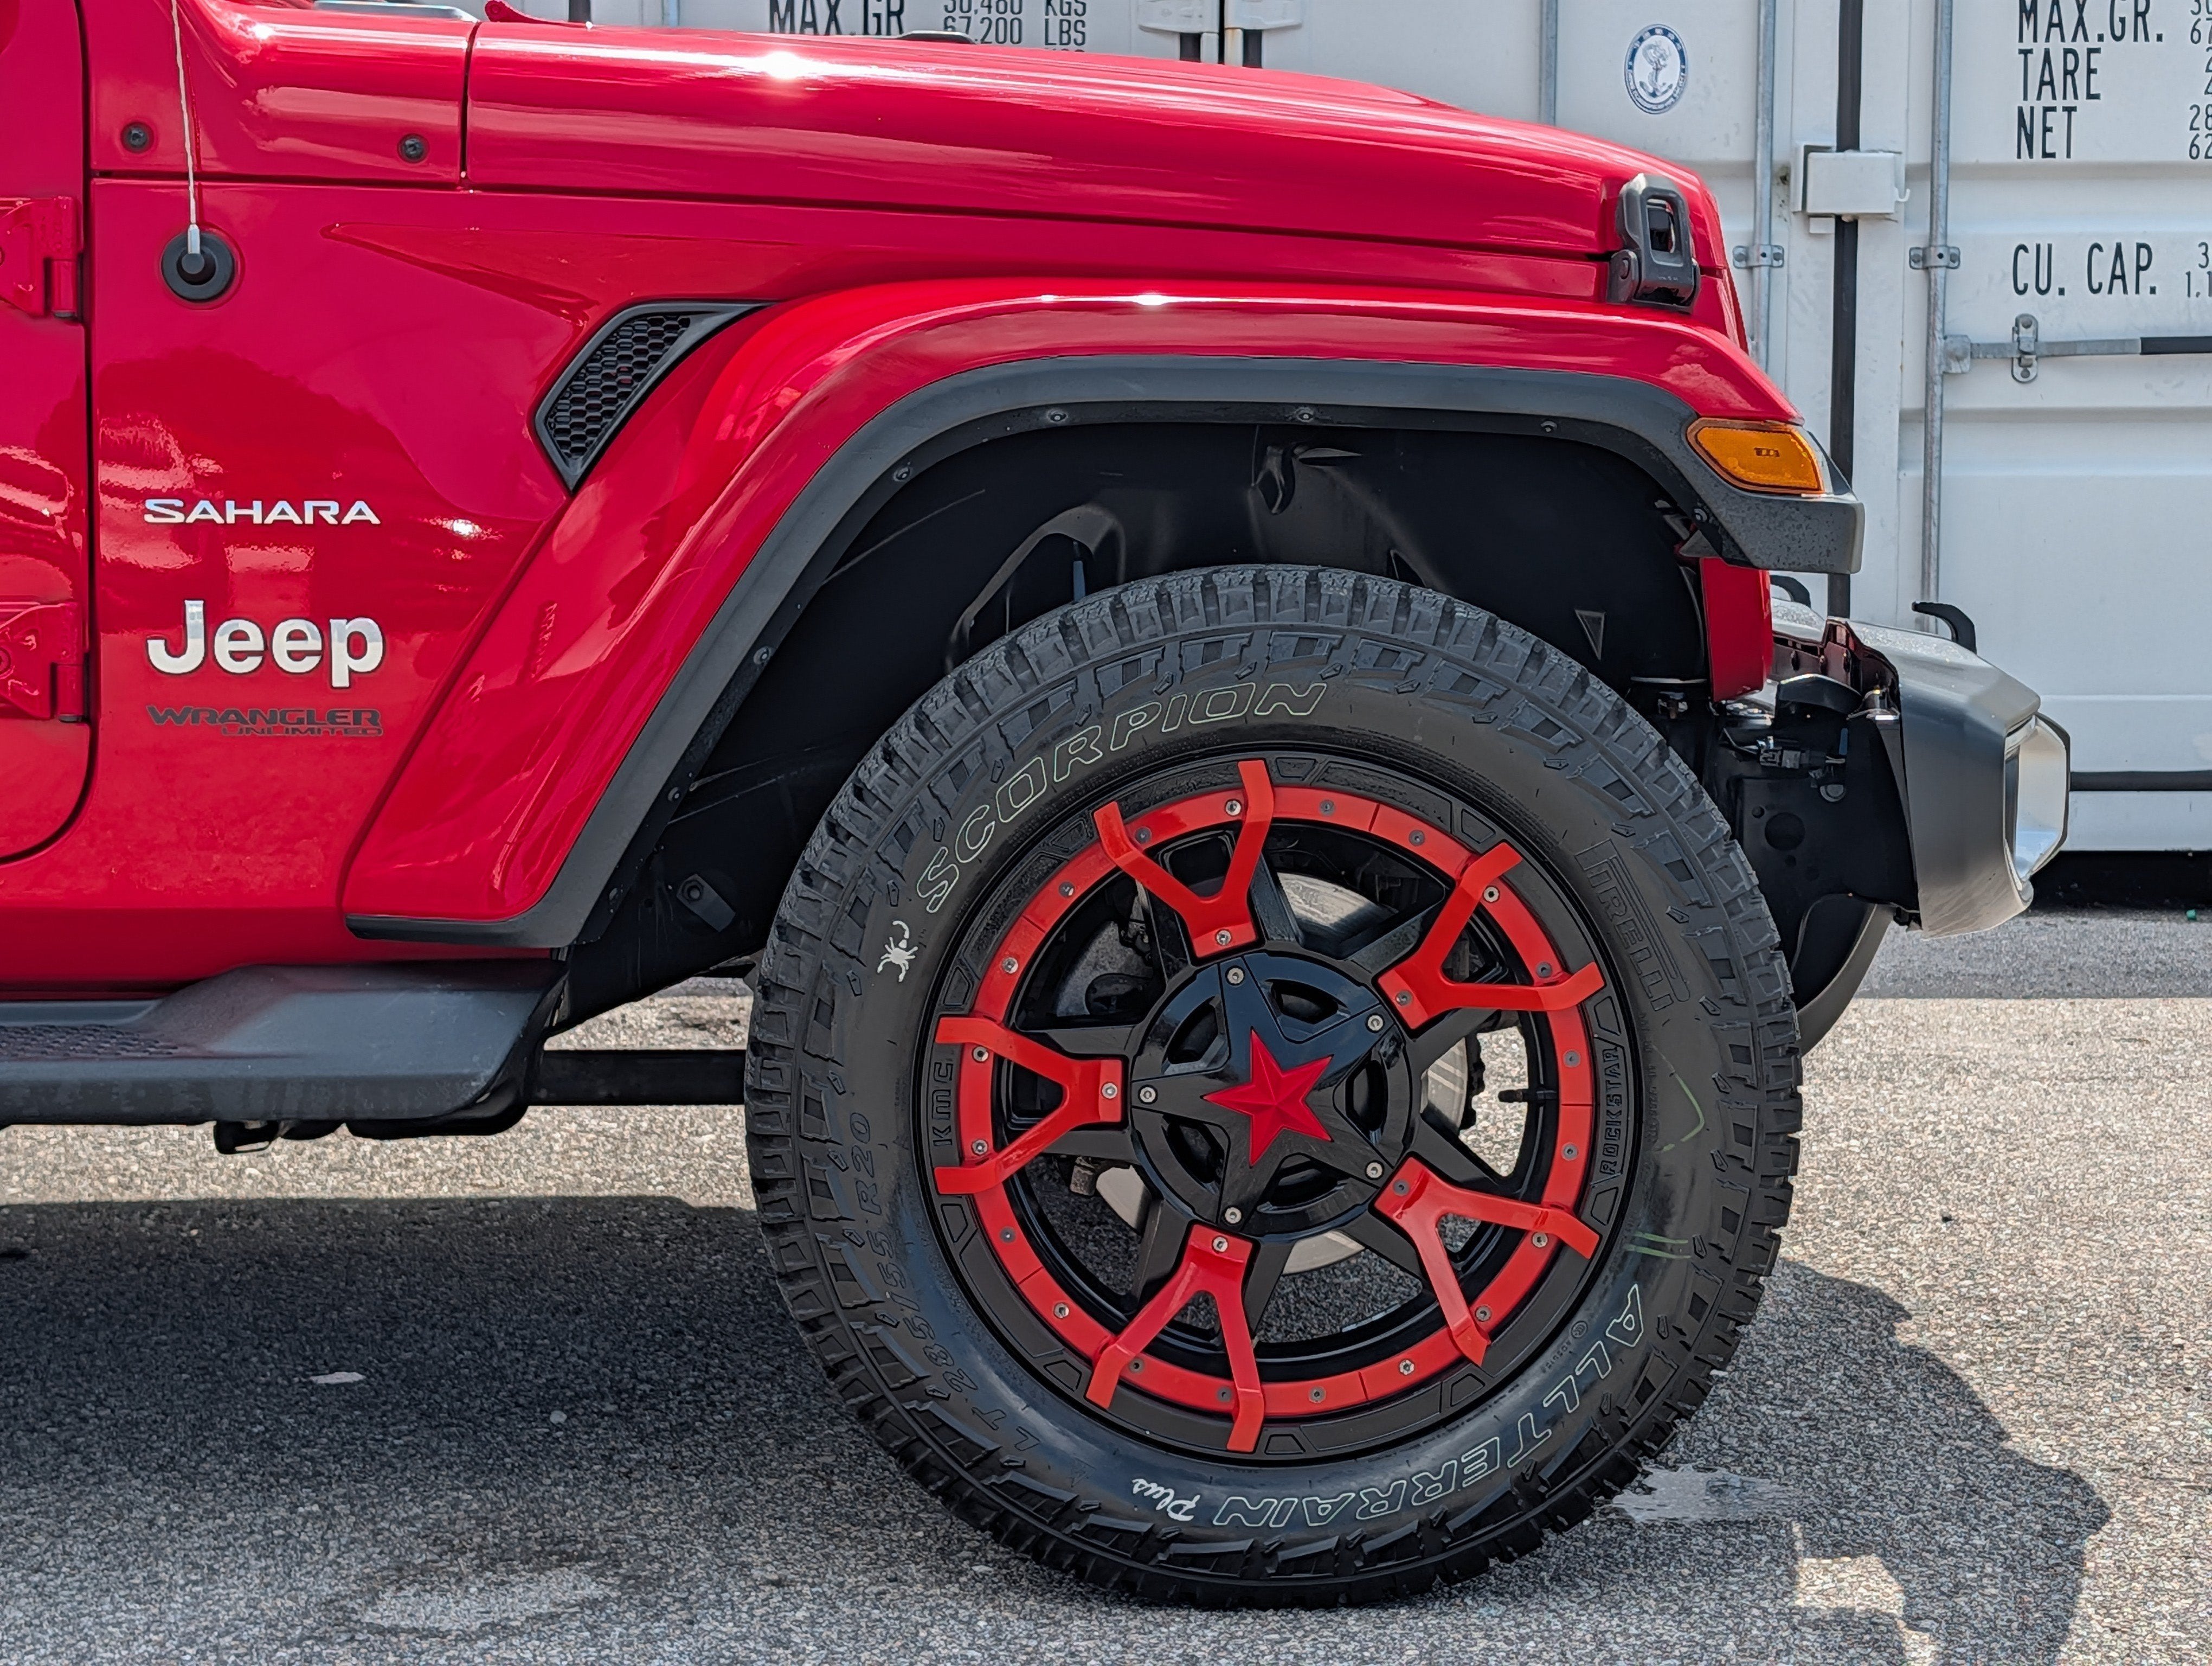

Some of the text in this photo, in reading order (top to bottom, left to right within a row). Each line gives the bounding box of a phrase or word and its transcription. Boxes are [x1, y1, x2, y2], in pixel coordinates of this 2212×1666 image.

[1045, 18, 1086, 46] LBS
[2018, 0, 2163, 43] MAX.GR.
[2018, 47, 2101, 101] TARE
[2016, 106, 2078, 159] NET
[2012, 243, 2065, 296] CU.
[2087, 242, 2157, 295] CAP.
[144, 498, 381, 525] SAHARA
[146, 599, 384, 688] Jeep
[145, 705, 382, 726] WRANGLER
[221, 724, 383, 737] UNLIMITED
[916, 682, 1328, 914] SCORPION
[1573, 838, 1690, 1012] PIRELLI
[933, 1061, 955, 1148] KMC
[1599, 1045, 1623, 1176] ROCKSTAR
[850, 1111, 882, 1215] R20
[866, 1229, 978, 1393] 285/55
[1131, 1283, 1644, 1528] ALL TERRAIN Plus
